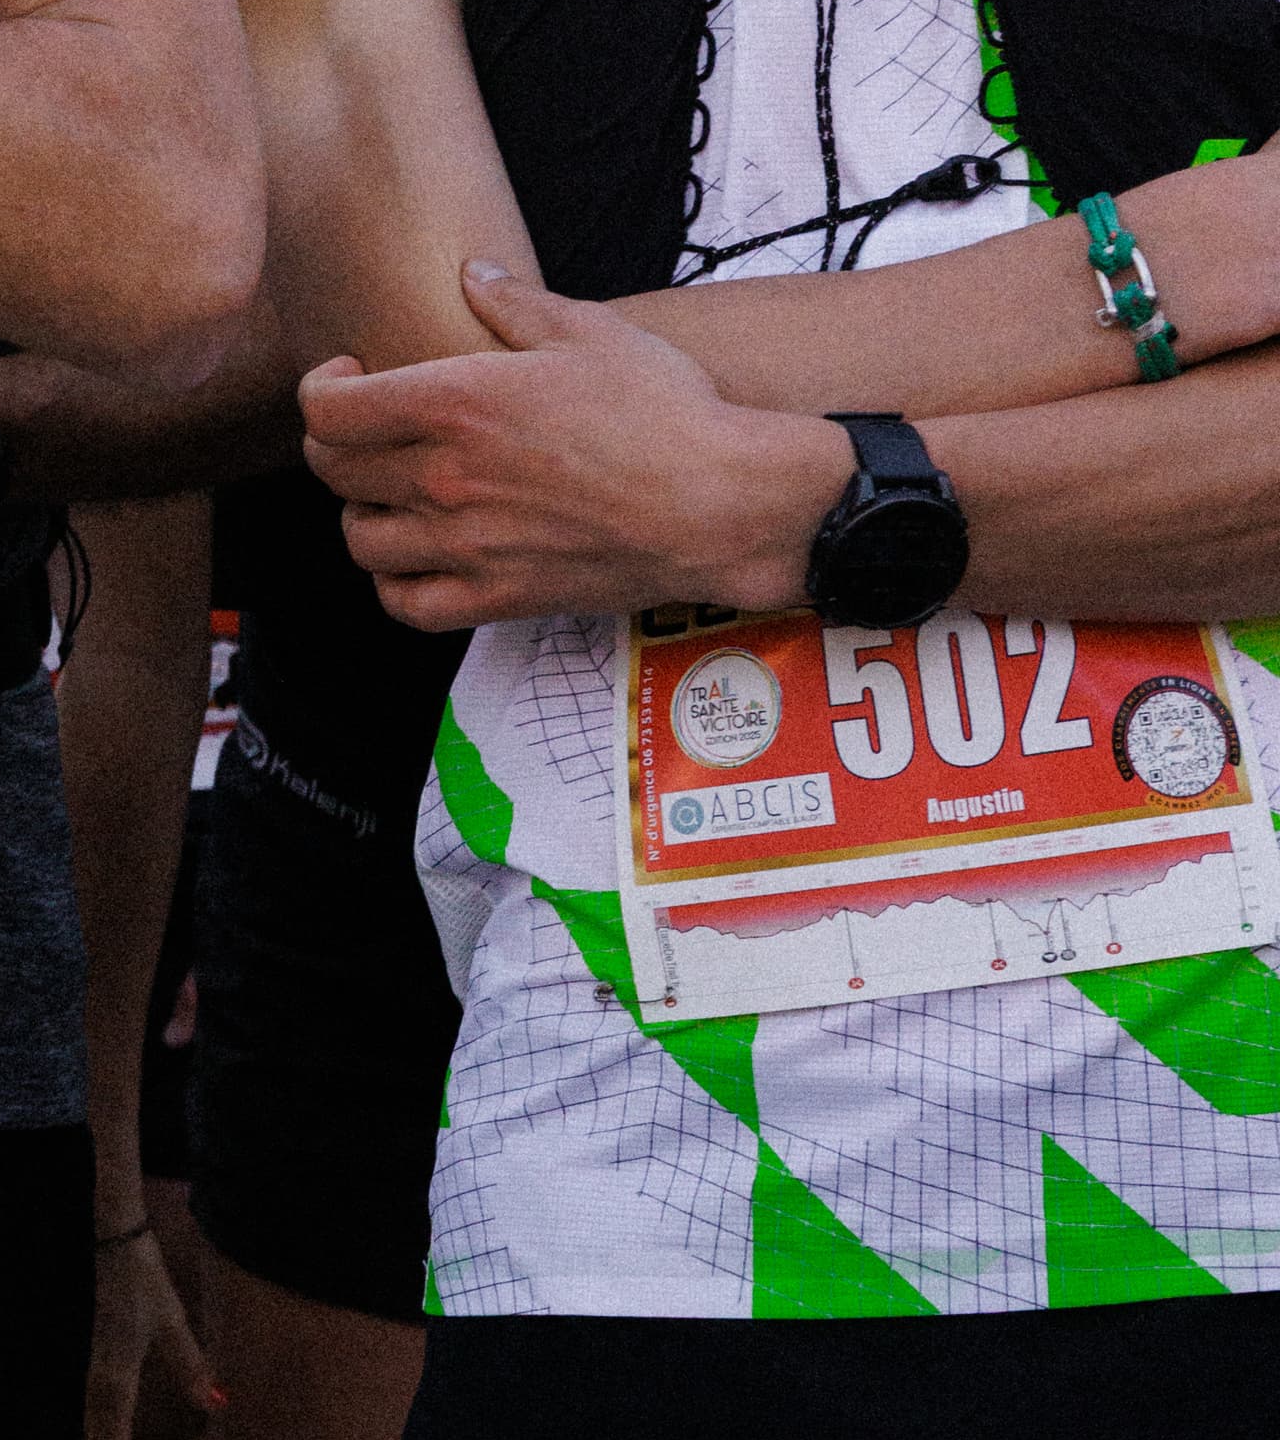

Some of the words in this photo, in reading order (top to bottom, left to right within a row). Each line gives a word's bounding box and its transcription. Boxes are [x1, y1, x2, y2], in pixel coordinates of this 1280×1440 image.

[642, 667, 654, 683] 14
[642, 686, 653, 704] 88
[690, 676, 737, 703] TRAIL
[821, 608, 1094, 781] 502
[641, 707, 653, 725] 53
[690, 697, 740, 719] SAINTE
[700, 709, 769, 733] VICTOIRE
[642, 727, 654, 745] 73
[642, 748, 654, 767] 06
[268, 750, 378, 839] Kalenji
[644, 769, 659, 841] d'urgence
[711, 779, 822, 824] ABCIS
[926, 786, 1025, 823] Augustin
